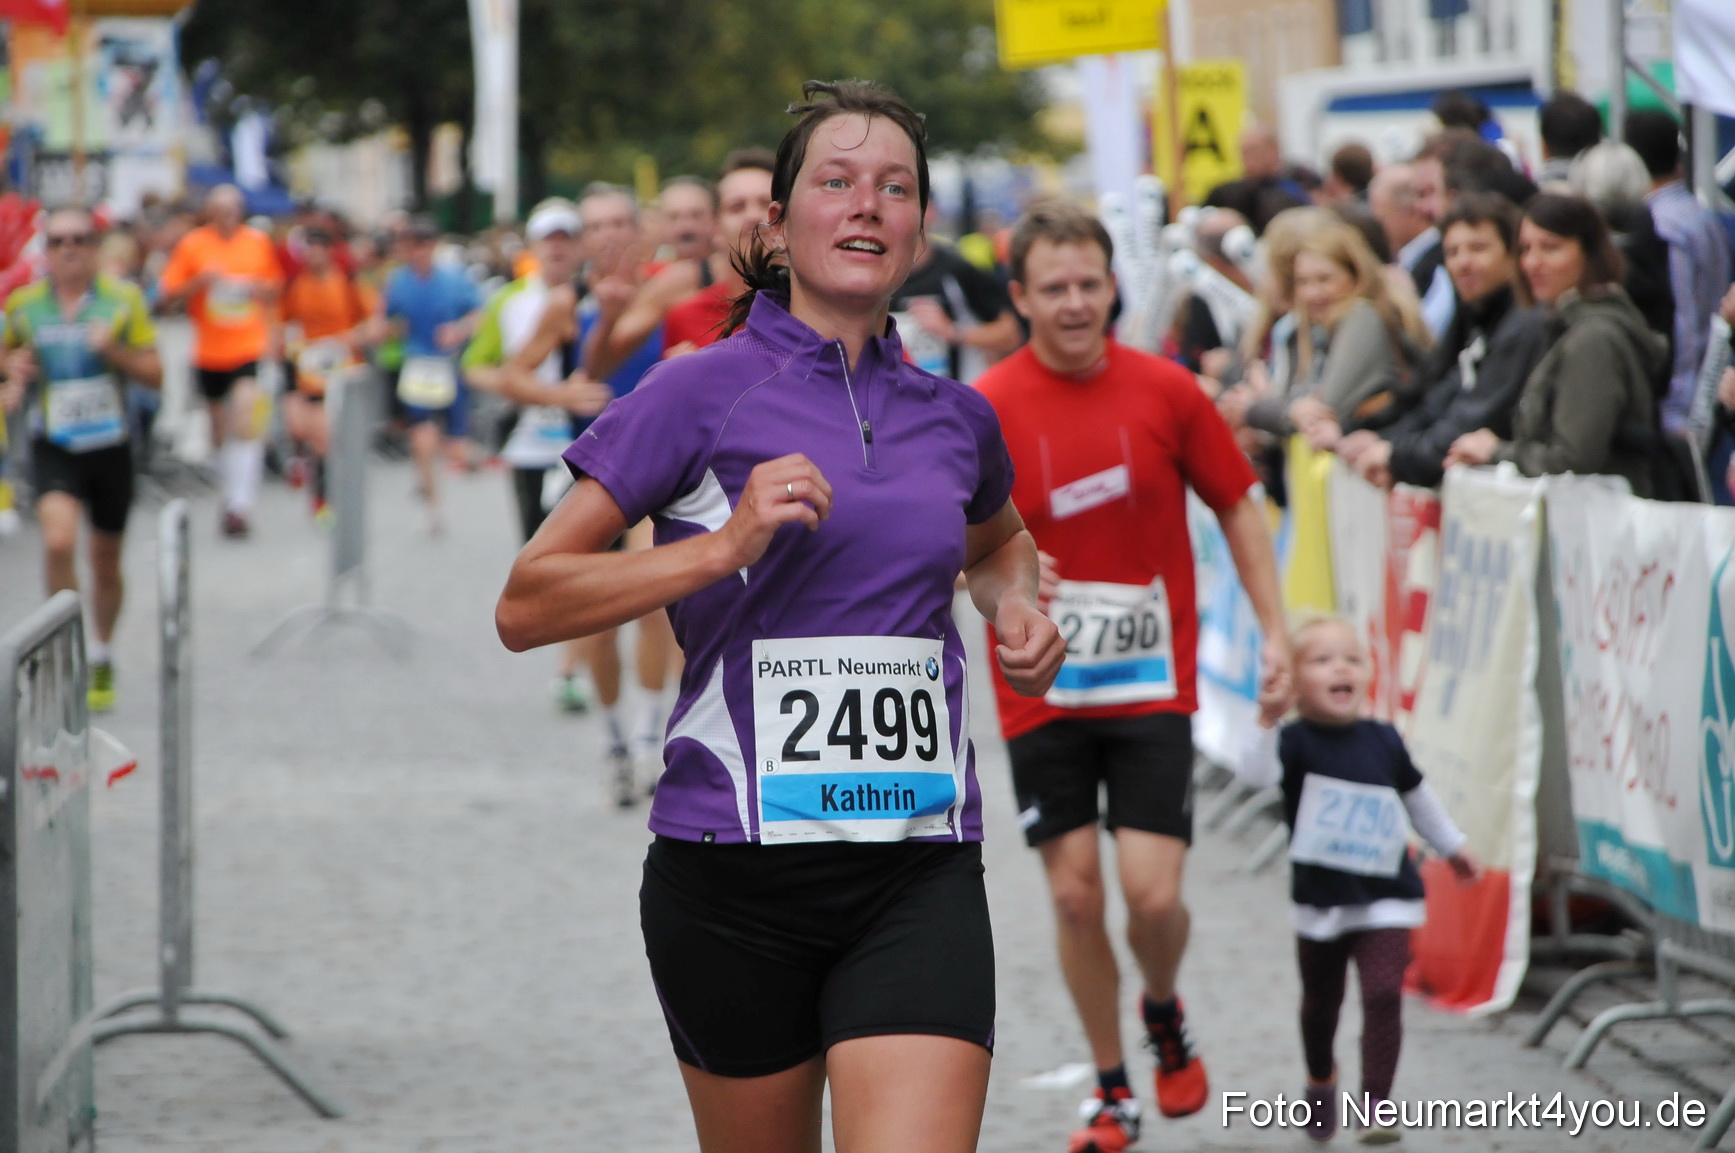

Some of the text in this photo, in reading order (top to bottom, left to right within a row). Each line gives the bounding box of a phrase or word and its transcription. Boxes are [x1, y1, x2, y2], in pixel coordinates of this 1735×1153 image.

[1181, 103, 1227, 163] A
[1061, 611, 1160, 655] 2790
[758, 657, 922, 679] PARTL Neumarkt
[779, 687, 939, 762] 2499
[766, 760, 775, 773] B
[820, 783, 917, 812] Kathrin
